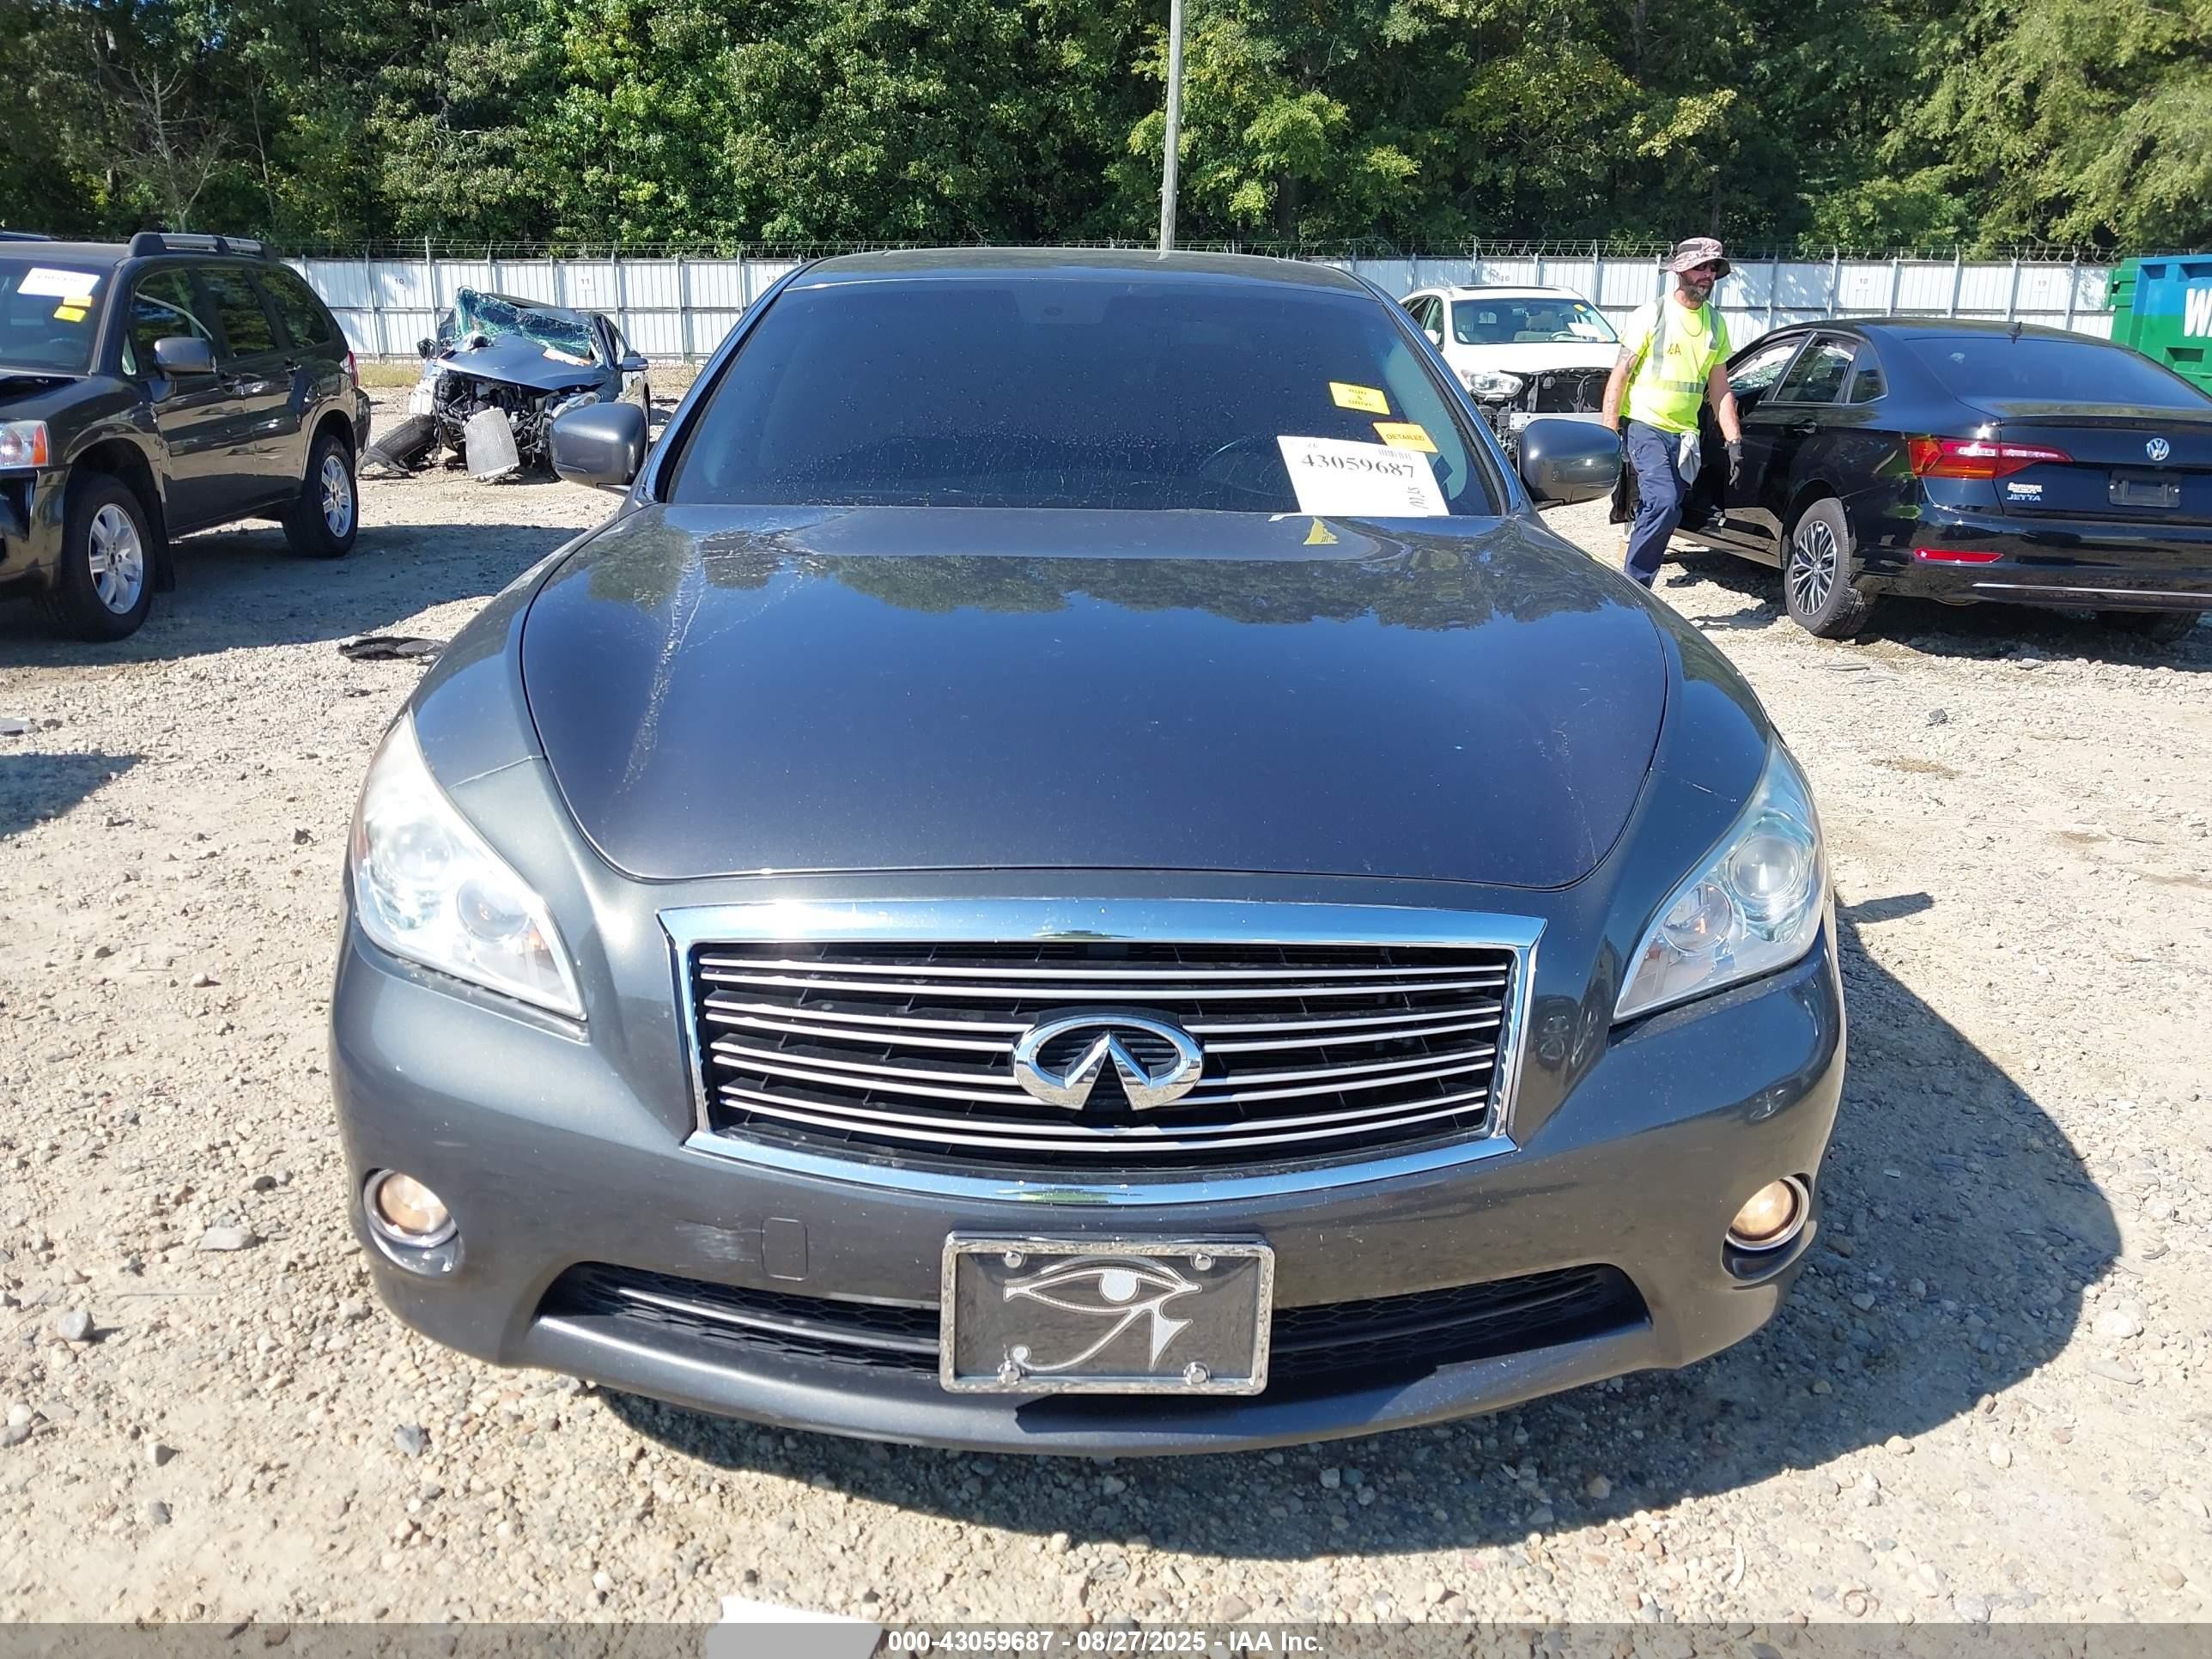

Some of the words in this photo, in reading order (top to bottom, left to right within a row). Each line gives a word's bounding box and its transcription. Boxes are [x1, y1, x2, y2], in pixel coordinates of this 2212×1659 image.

[2184, 288, 2212, 337] W
[1386, 433, 1425, 441] DETAILED
[1301, 453, 1414, 478] 43059687
[2007, 493, 2042, 501] JETTA
